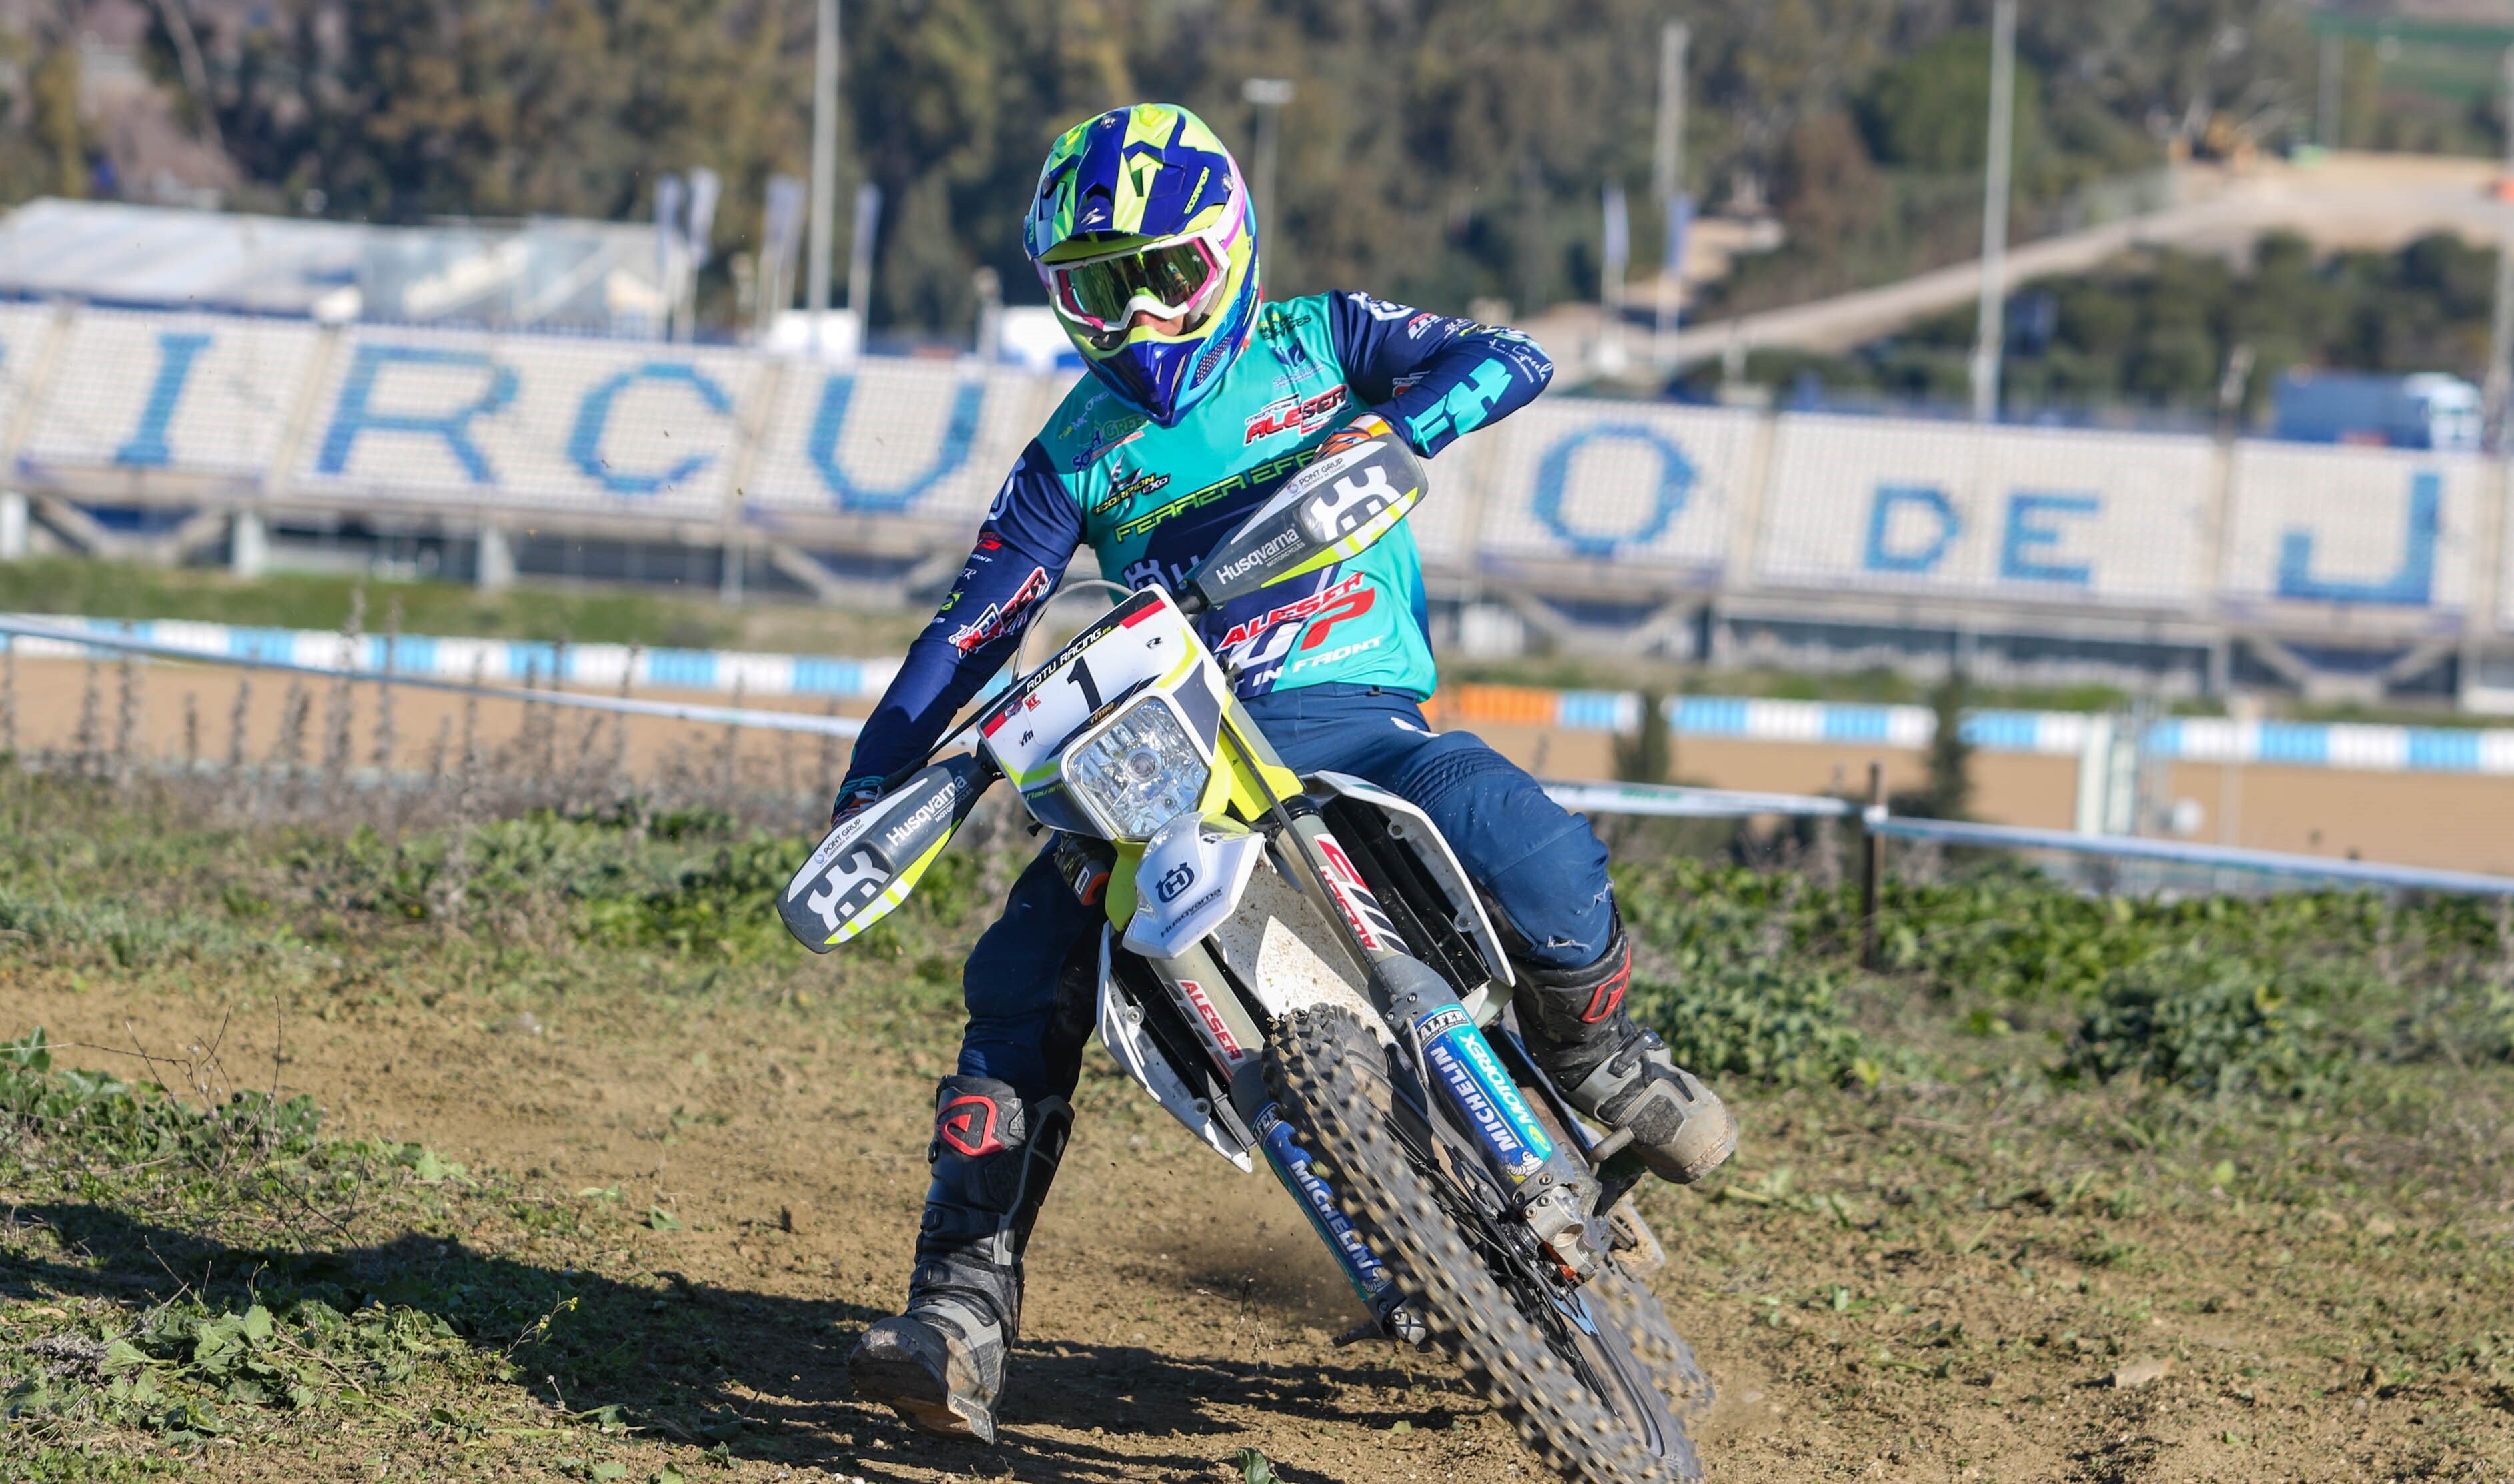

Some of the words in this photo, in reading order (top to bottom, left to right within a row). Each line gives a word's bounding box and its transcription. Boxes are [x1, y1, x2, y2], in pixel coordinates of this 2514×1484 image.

[1184, 166, 1210, 214] SCORPION
[1299, 469, 1320, 486] PONT
[1321, 458, 1343, 473] GRUP
[1115, 476, 1247, 543] FERRER
[1864, 480, 2100, 585] DE
[1215, 526, 1300, 585] Husqvarna
[1265, 542, 1305, 568] MOTORCYCLES
[1027, 660, 1058, 693] ROTU
[1067, 655, 1103, 714] 1
[1252, 666, 1284, 687] IN
[1292, 635, 1385, 674] FRONT
[823, 834, 842, 854] PONT
[842, 818, 861, 836] GRUP
[886, 776, 967, 847] Husqvarna
[1161, 886, 1223, 938] Husqvarna
[1180, 980, 1245, 1062] ALESER
[1420, 1010, 1467, 1042] ALFER
[1429, 1045, 1519, 1155] MICHELIN
[1459, 1032, 1535, 1128] MOTOREX
[1289, 1159, 1373, 1270] MICHELIN
